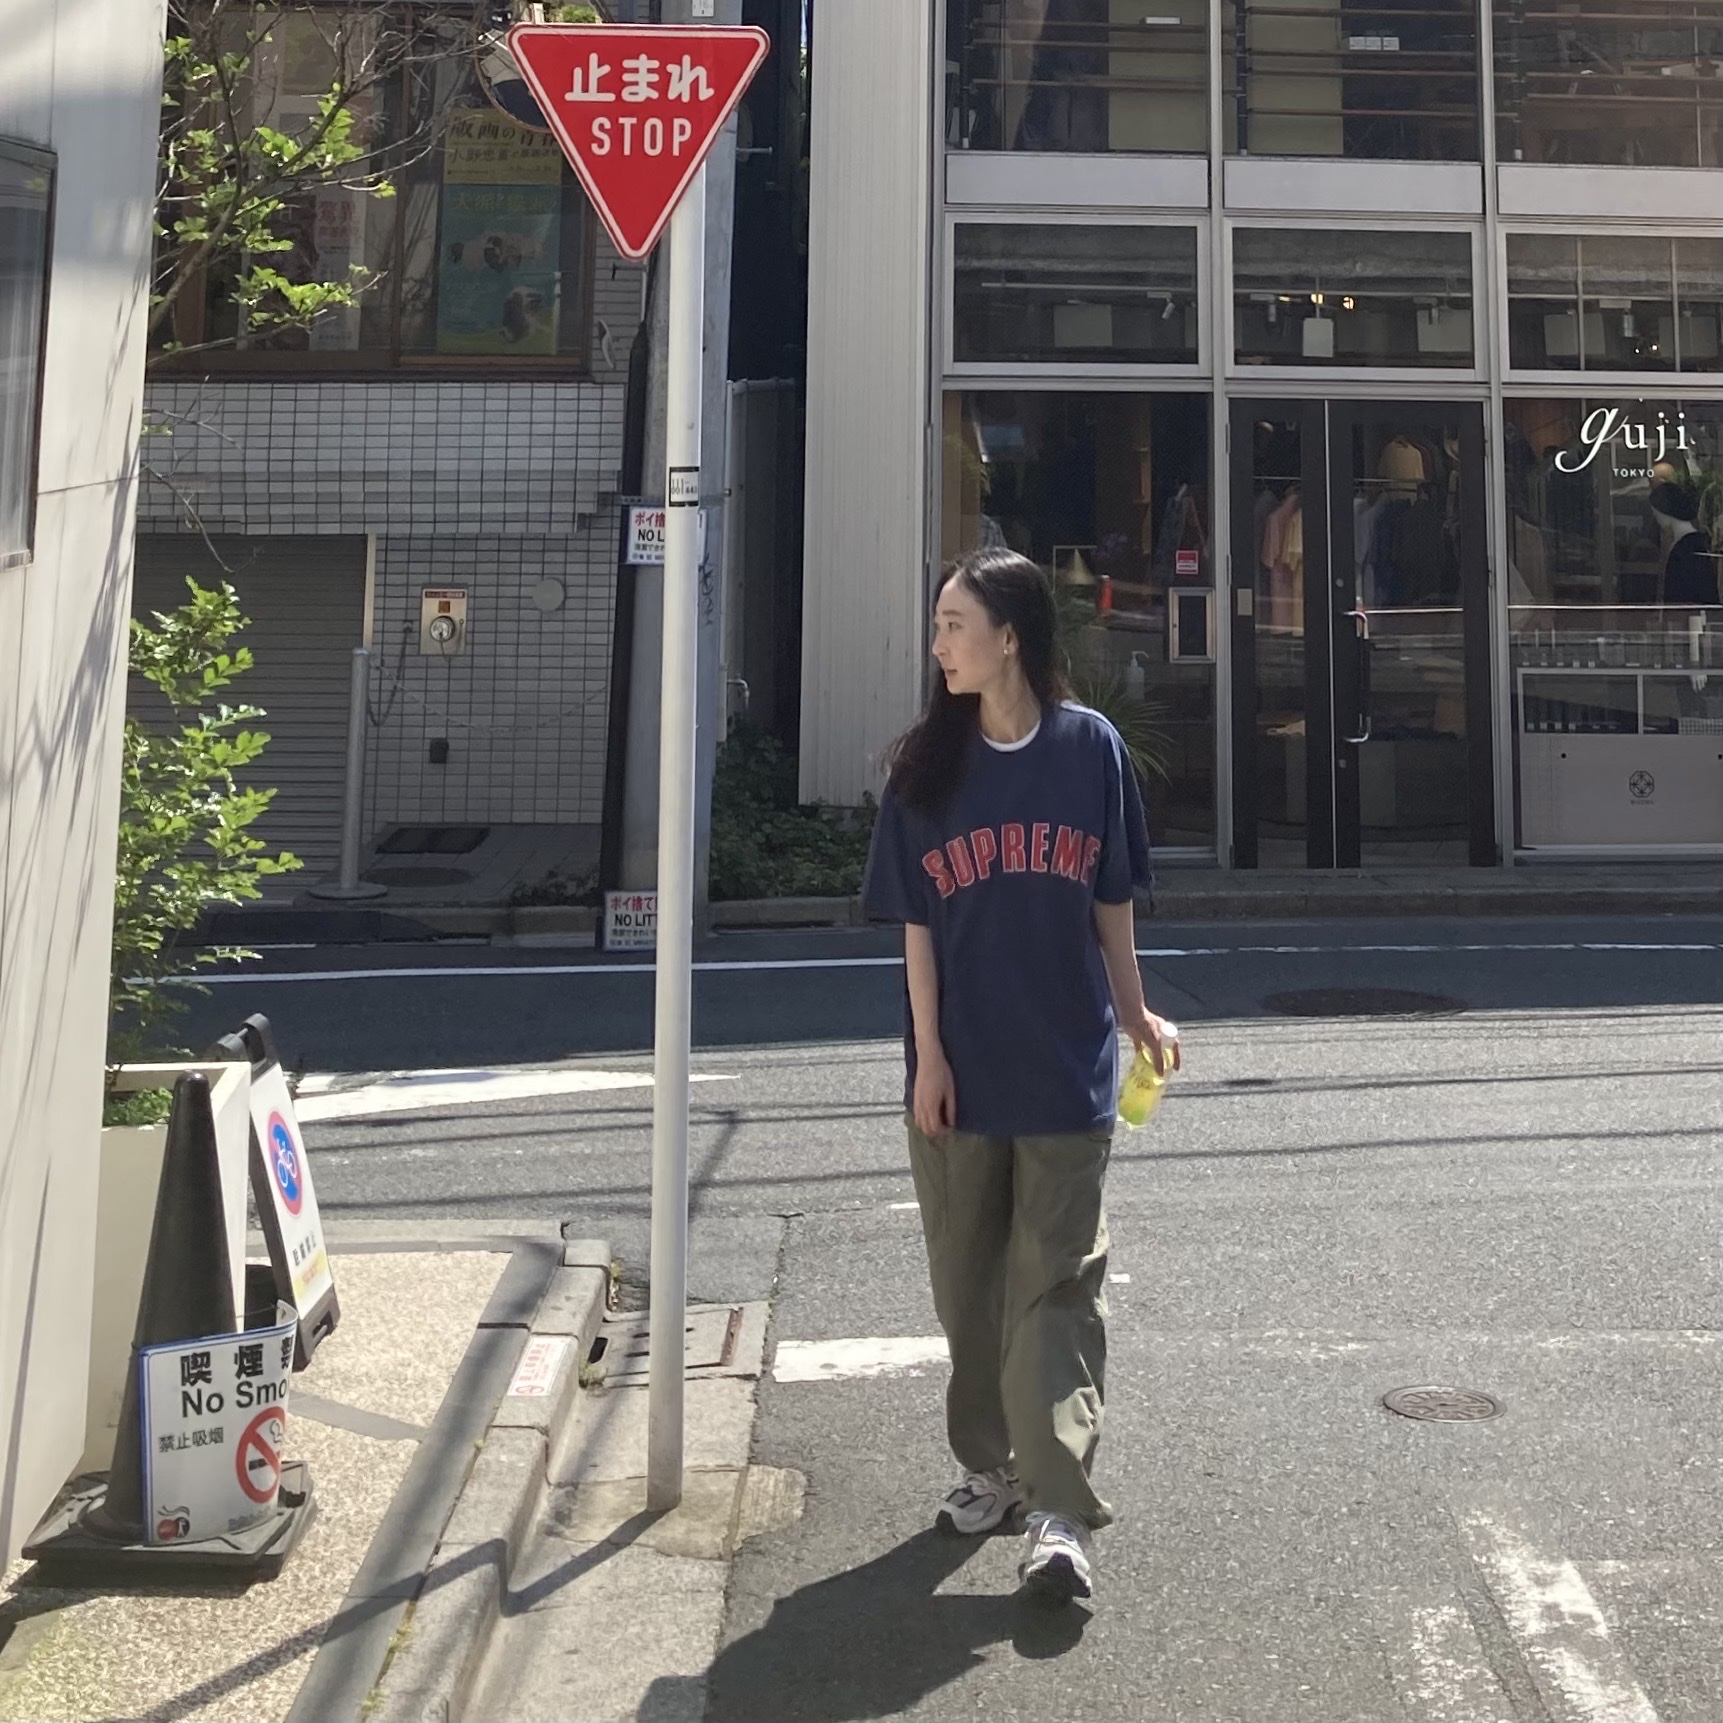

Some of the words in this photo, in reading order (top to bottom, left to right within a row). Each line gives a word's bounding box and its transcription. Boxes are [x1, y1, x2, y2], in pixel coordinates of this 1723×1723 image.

[564, 52, 715, 103] 止まれ
[591, 116, 692, 156] STOP
[1554, 407, 1689, 473] guji
[1612, 468, 1655, 478] TOKYO
[638, 529, 654, 541] NO
[611, 895, 658, 911] ポイ捨て
[614, 913, 632, 927] NO
[182, 1388, 224, 1418] No
[159, 1427, 224, 1453] 禁止吸烟
